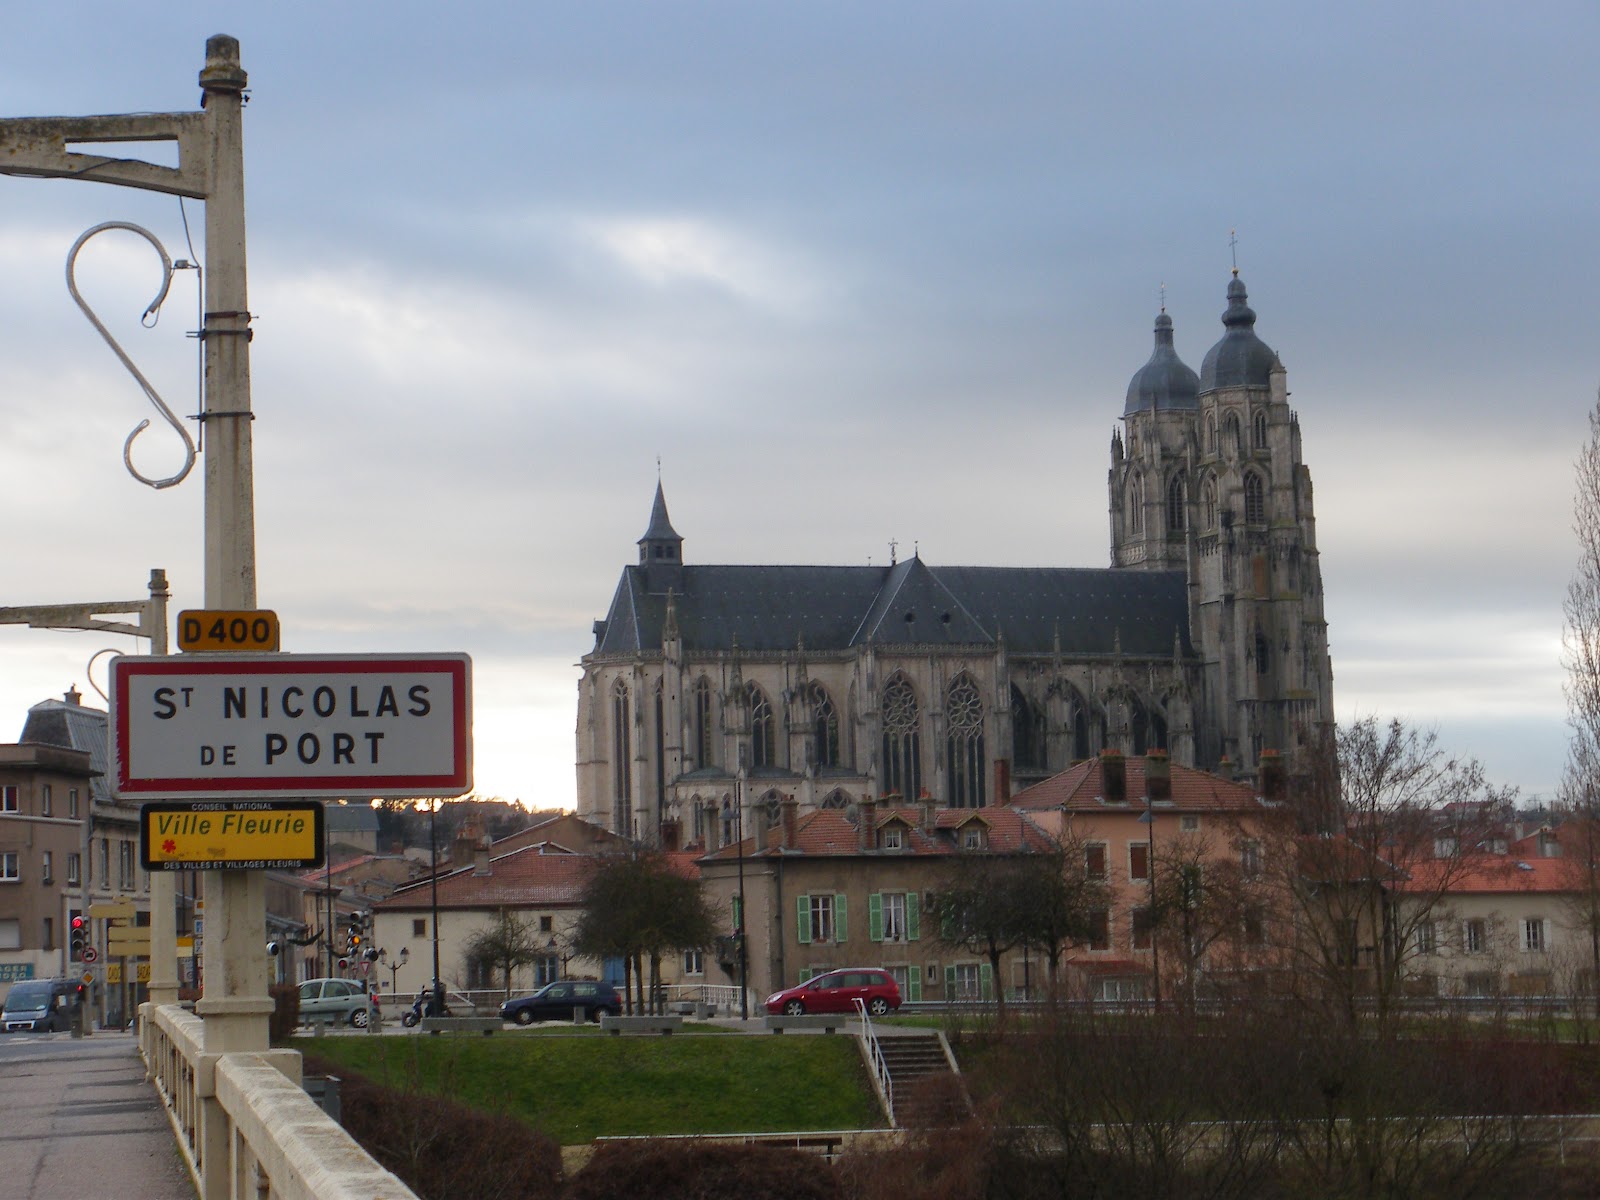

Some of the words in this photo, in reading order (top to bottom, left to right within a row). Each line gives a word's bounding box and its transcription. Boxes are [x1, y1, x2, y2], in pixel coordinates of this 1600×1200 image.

[223, 685, 431, 719] NICOLAS
[200, 745, 236, 766] DE
[265, 732, 385, 765] PORT
[191, 803, 228, 811] CONSEIL
[232, 802, 273, 810] NATIONAL
[158, 814, 212, 835] Ville
[221, 813, 305, 834] Fleurie
[163, 861, 180, 870] DES
[182, 861, 212, 870] VILLES
[213, 861, 223, 869] ET
[226, 860, 266, 869] VILLAGES
[267, 859, 302, 868] FLEURIS
